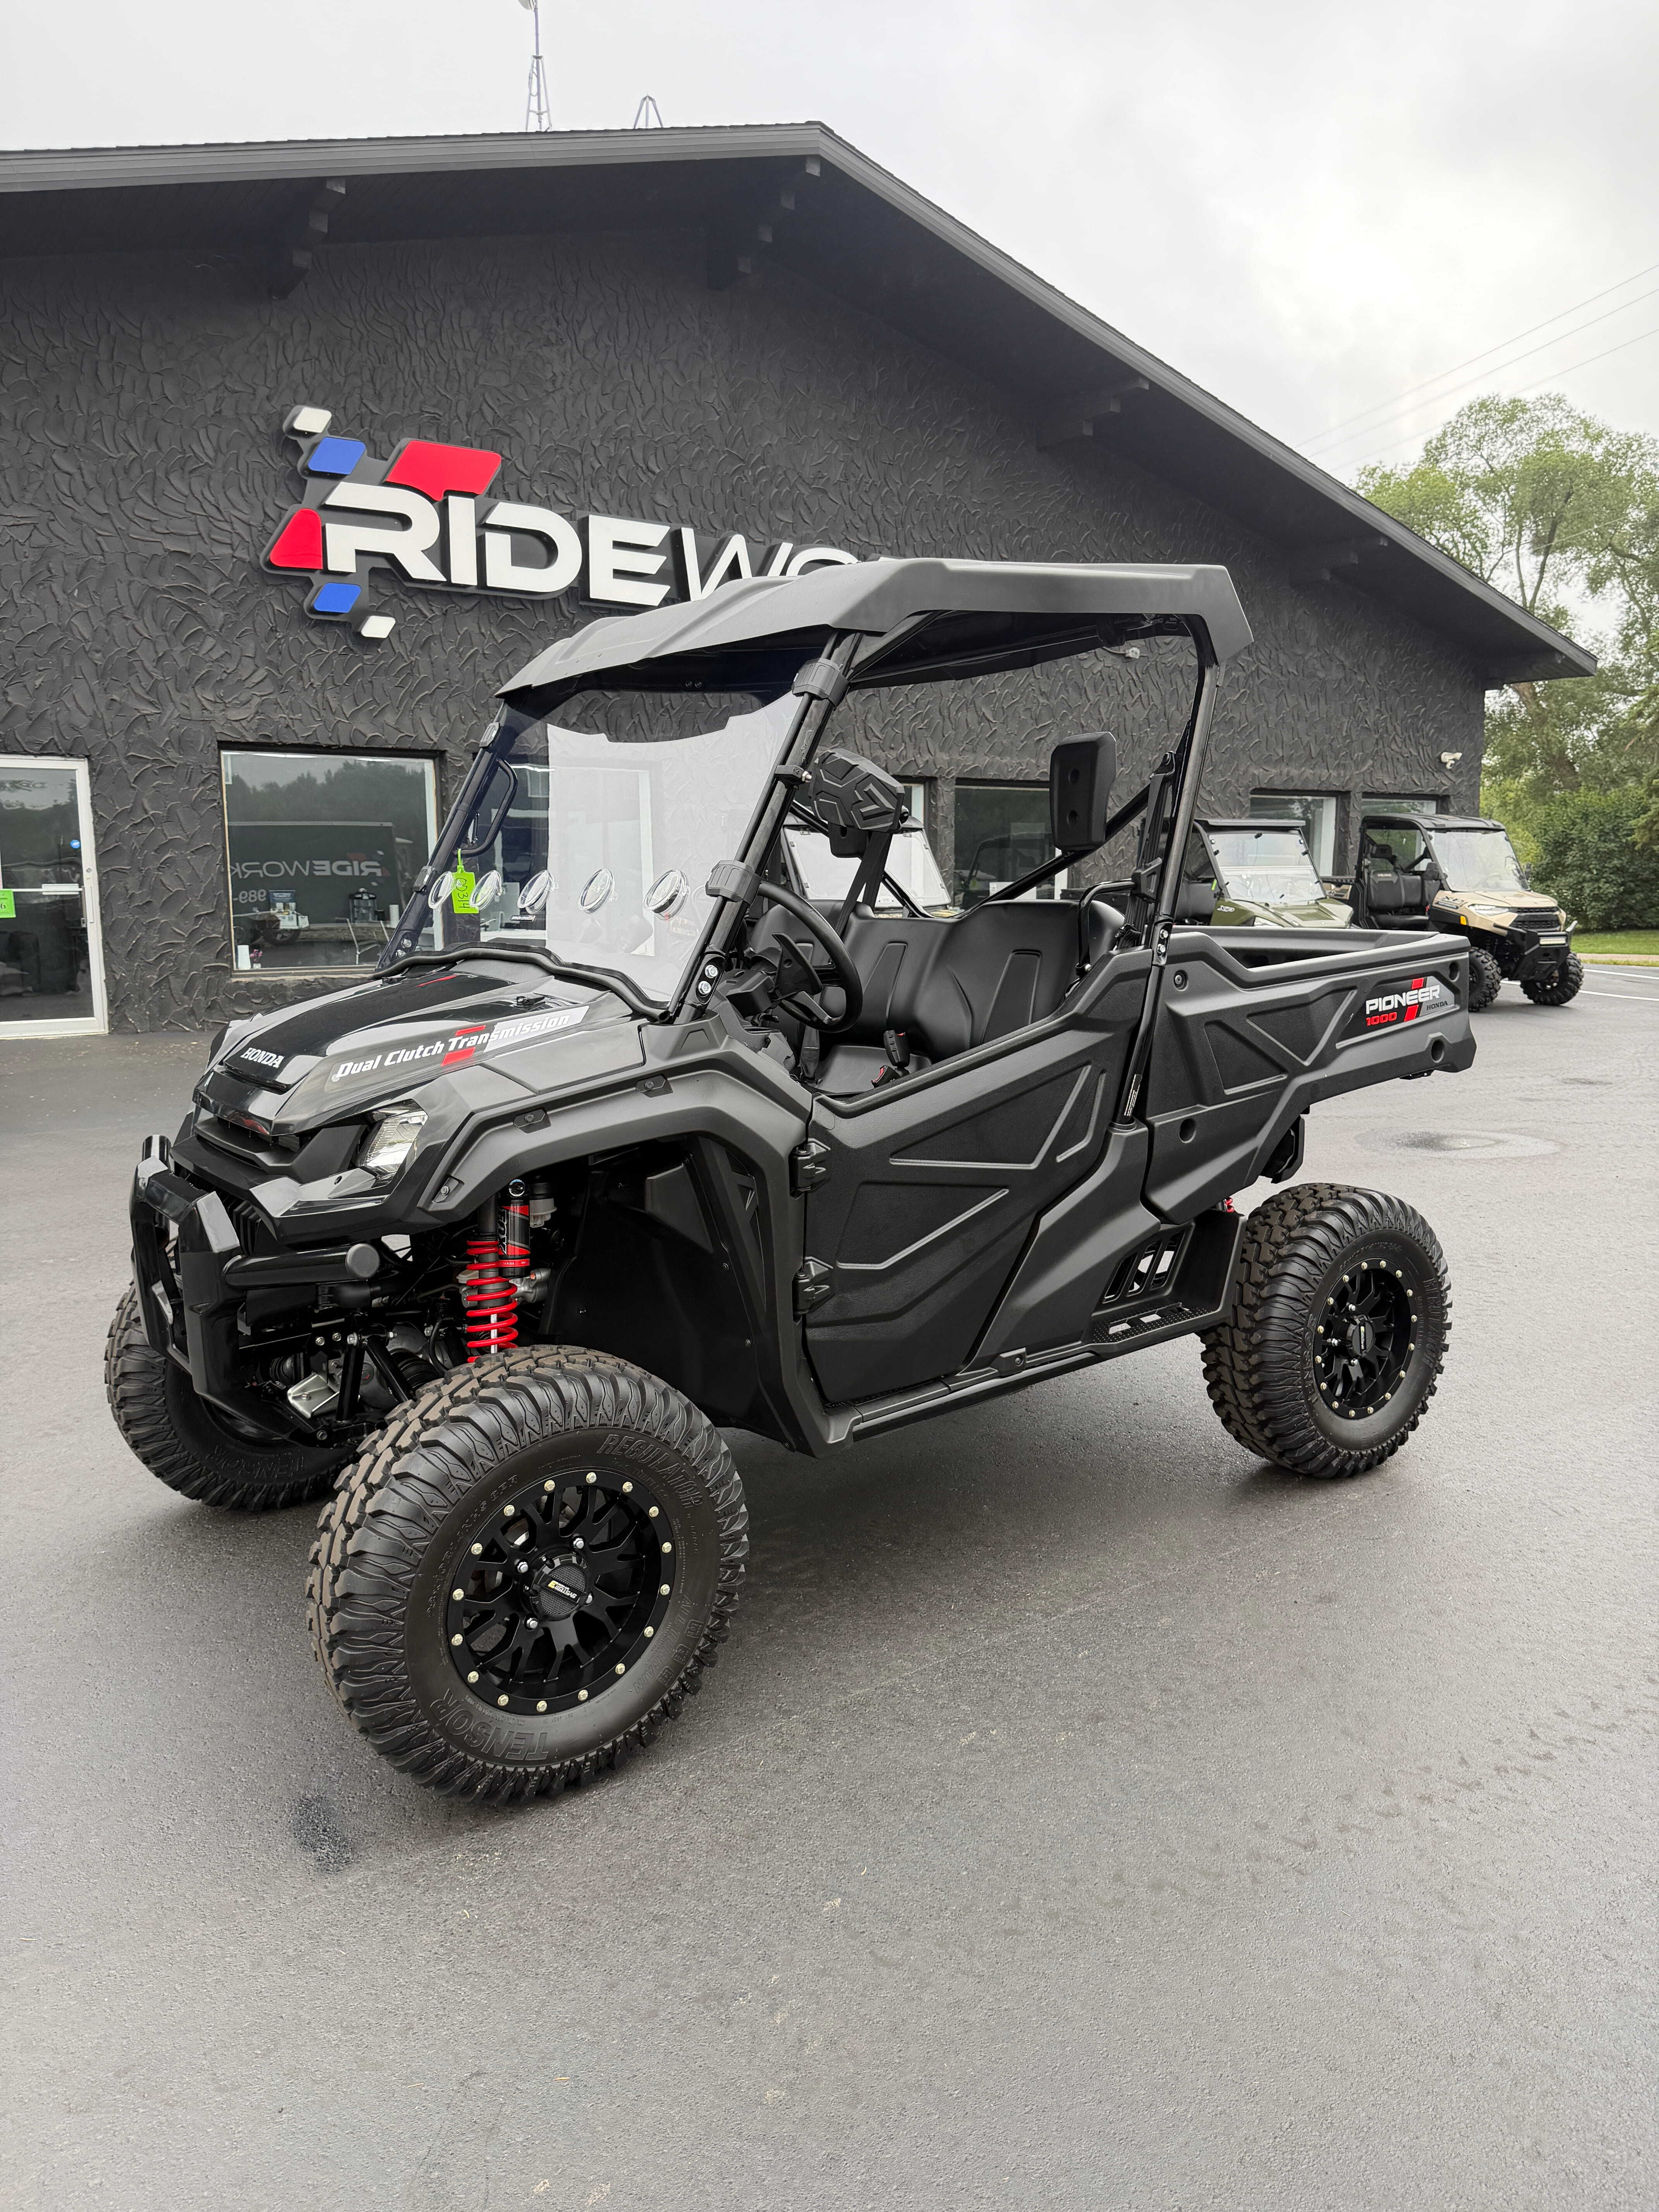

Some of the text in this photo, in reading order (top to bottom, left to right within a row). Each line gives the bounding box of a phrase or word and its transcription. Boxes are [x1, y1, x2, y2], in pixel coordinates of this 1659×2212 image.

[1366, 984, 1440, 1015] PIONEER
[1426, 1001, 1448, 1011] HONDA
[1366, 1012, 1397, 1026] 1000
[240, 1047, 285, 1068] HONDA
[335, 1015, 570, 1080] Dual Clutch Transmission
[596, 1434, 703, 1509] REGULATOR
[429, 1688, 549, 1760] TENSOR
